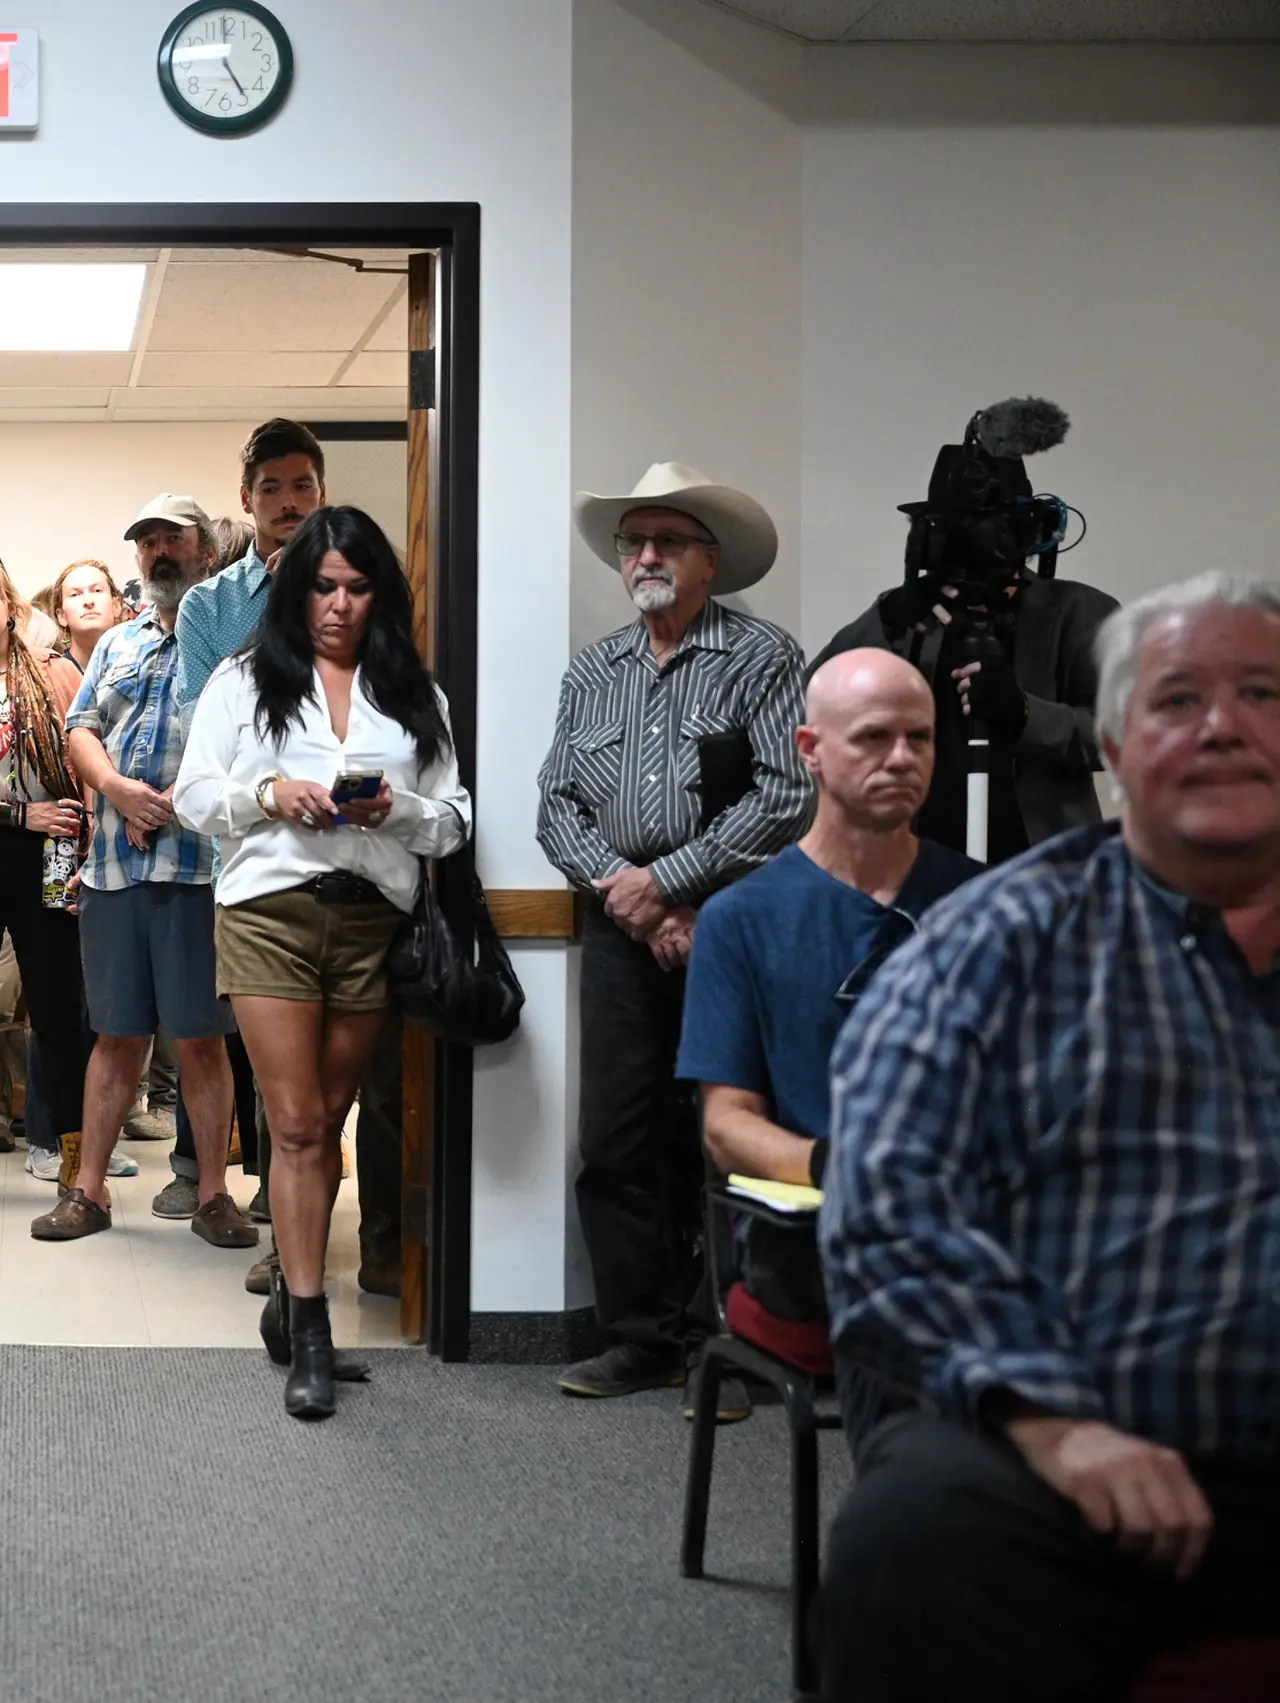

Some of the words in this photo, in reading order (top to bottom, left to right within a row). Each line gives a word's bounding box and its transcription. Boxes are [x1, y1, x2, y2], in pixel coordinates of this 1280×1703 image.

[204, 21, 216, 41] 11
[219, 17, 236, 36] 12
[241, 20, 246, 39] 1
[251, 32, 263, 52] 2
[260, 53, 272, 74] 3
[187, 76, 199, 95] 8
[251, 75, 265, 93] 4
[205, 88, 218, 107] 7
[218, 92, 232, 112] 6
[236, 87, 249, 107] 5
